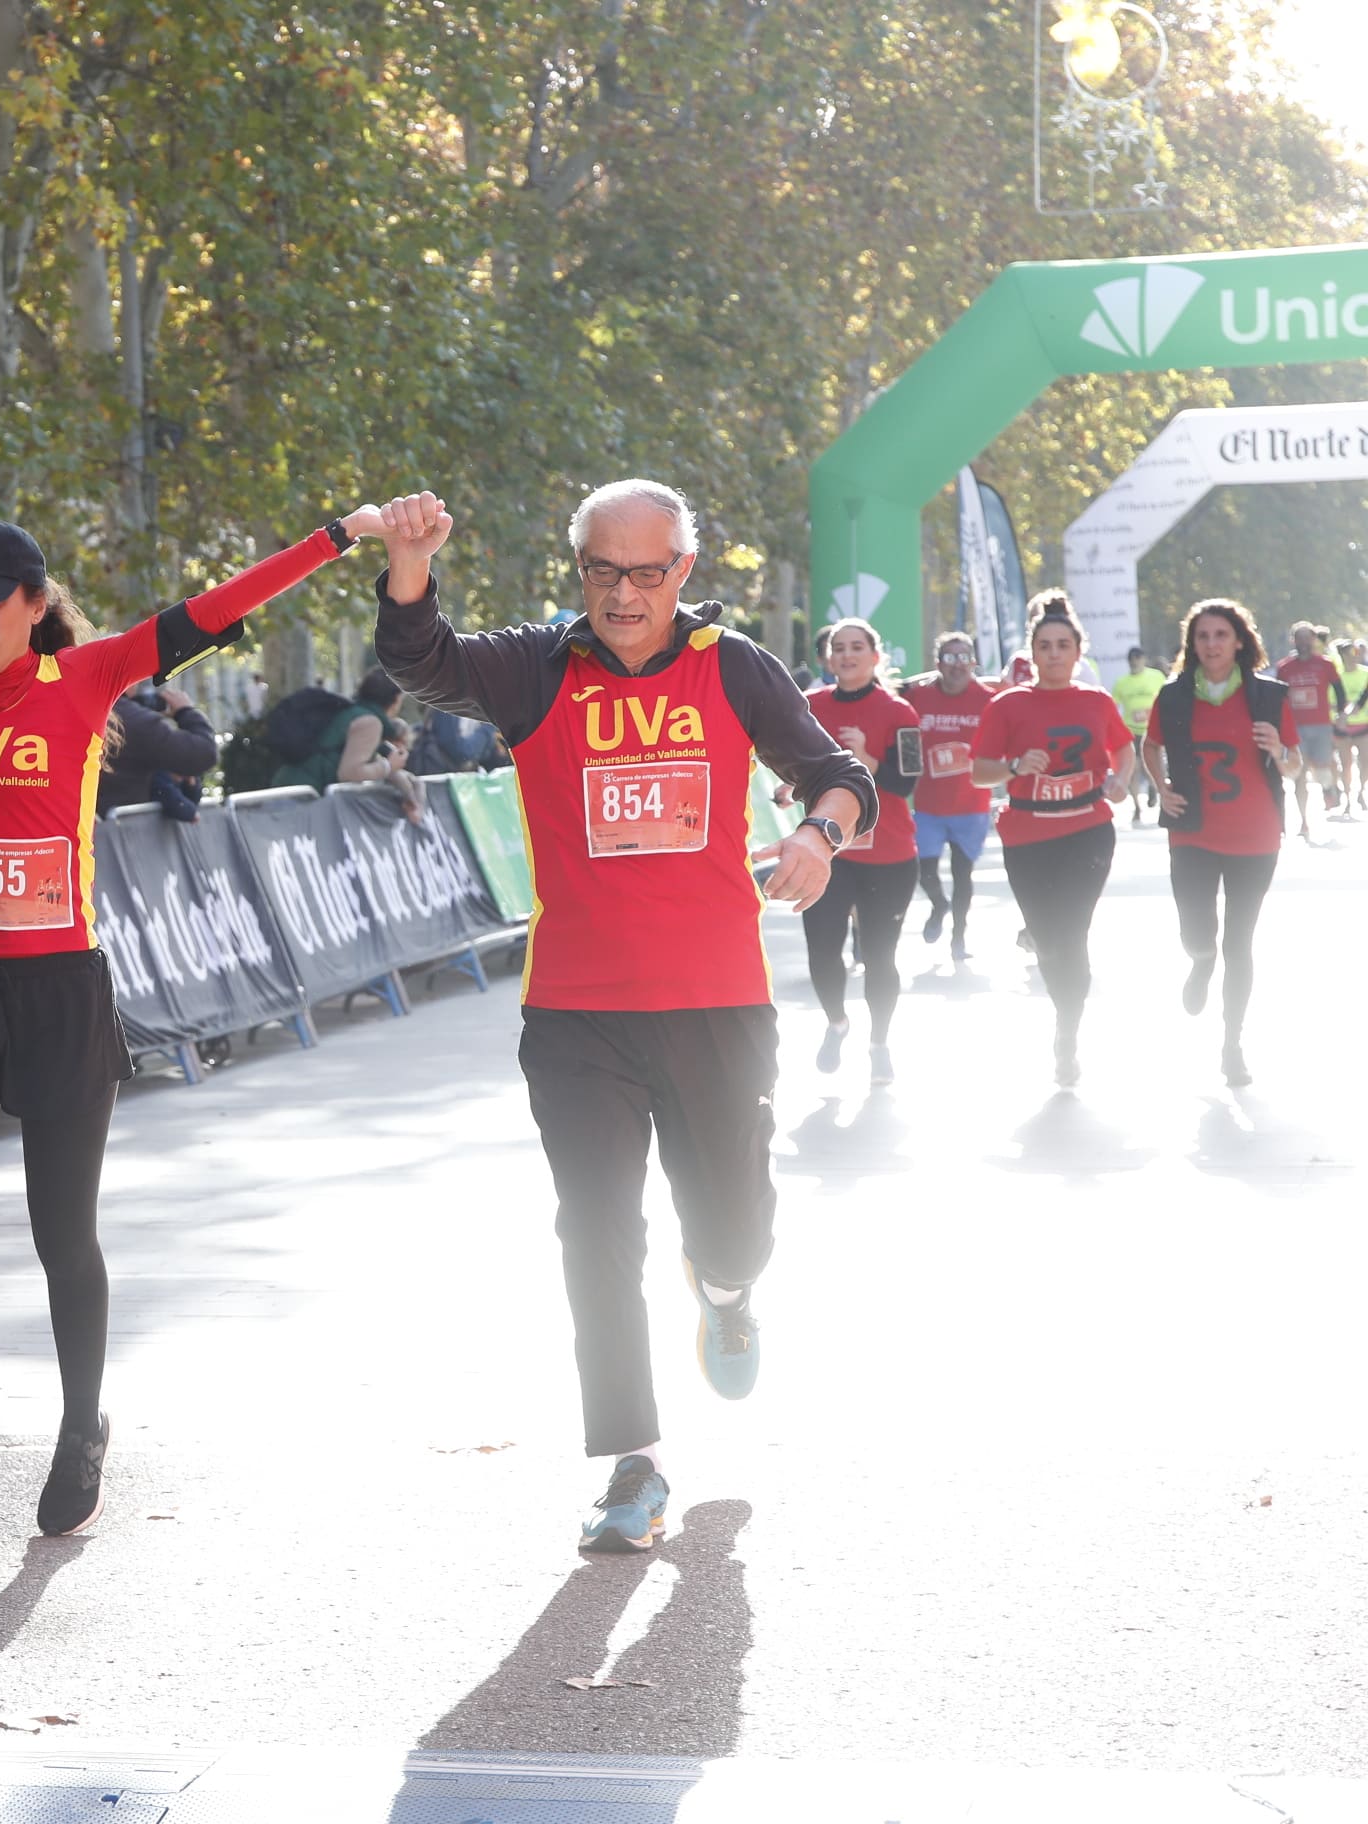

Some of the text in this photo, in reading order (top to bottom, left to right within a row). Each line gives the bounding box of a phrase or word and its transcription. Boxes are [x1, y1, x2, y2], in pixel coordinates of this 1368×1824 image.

[1219, 430, 1258, 463] El
[1266, 425, 1350, 461] Norte
[586, 696, 705, 751] UVa
[585, 748, 707, 766] Universidad de Valladolid
[602, 782, 664, 822] 854
